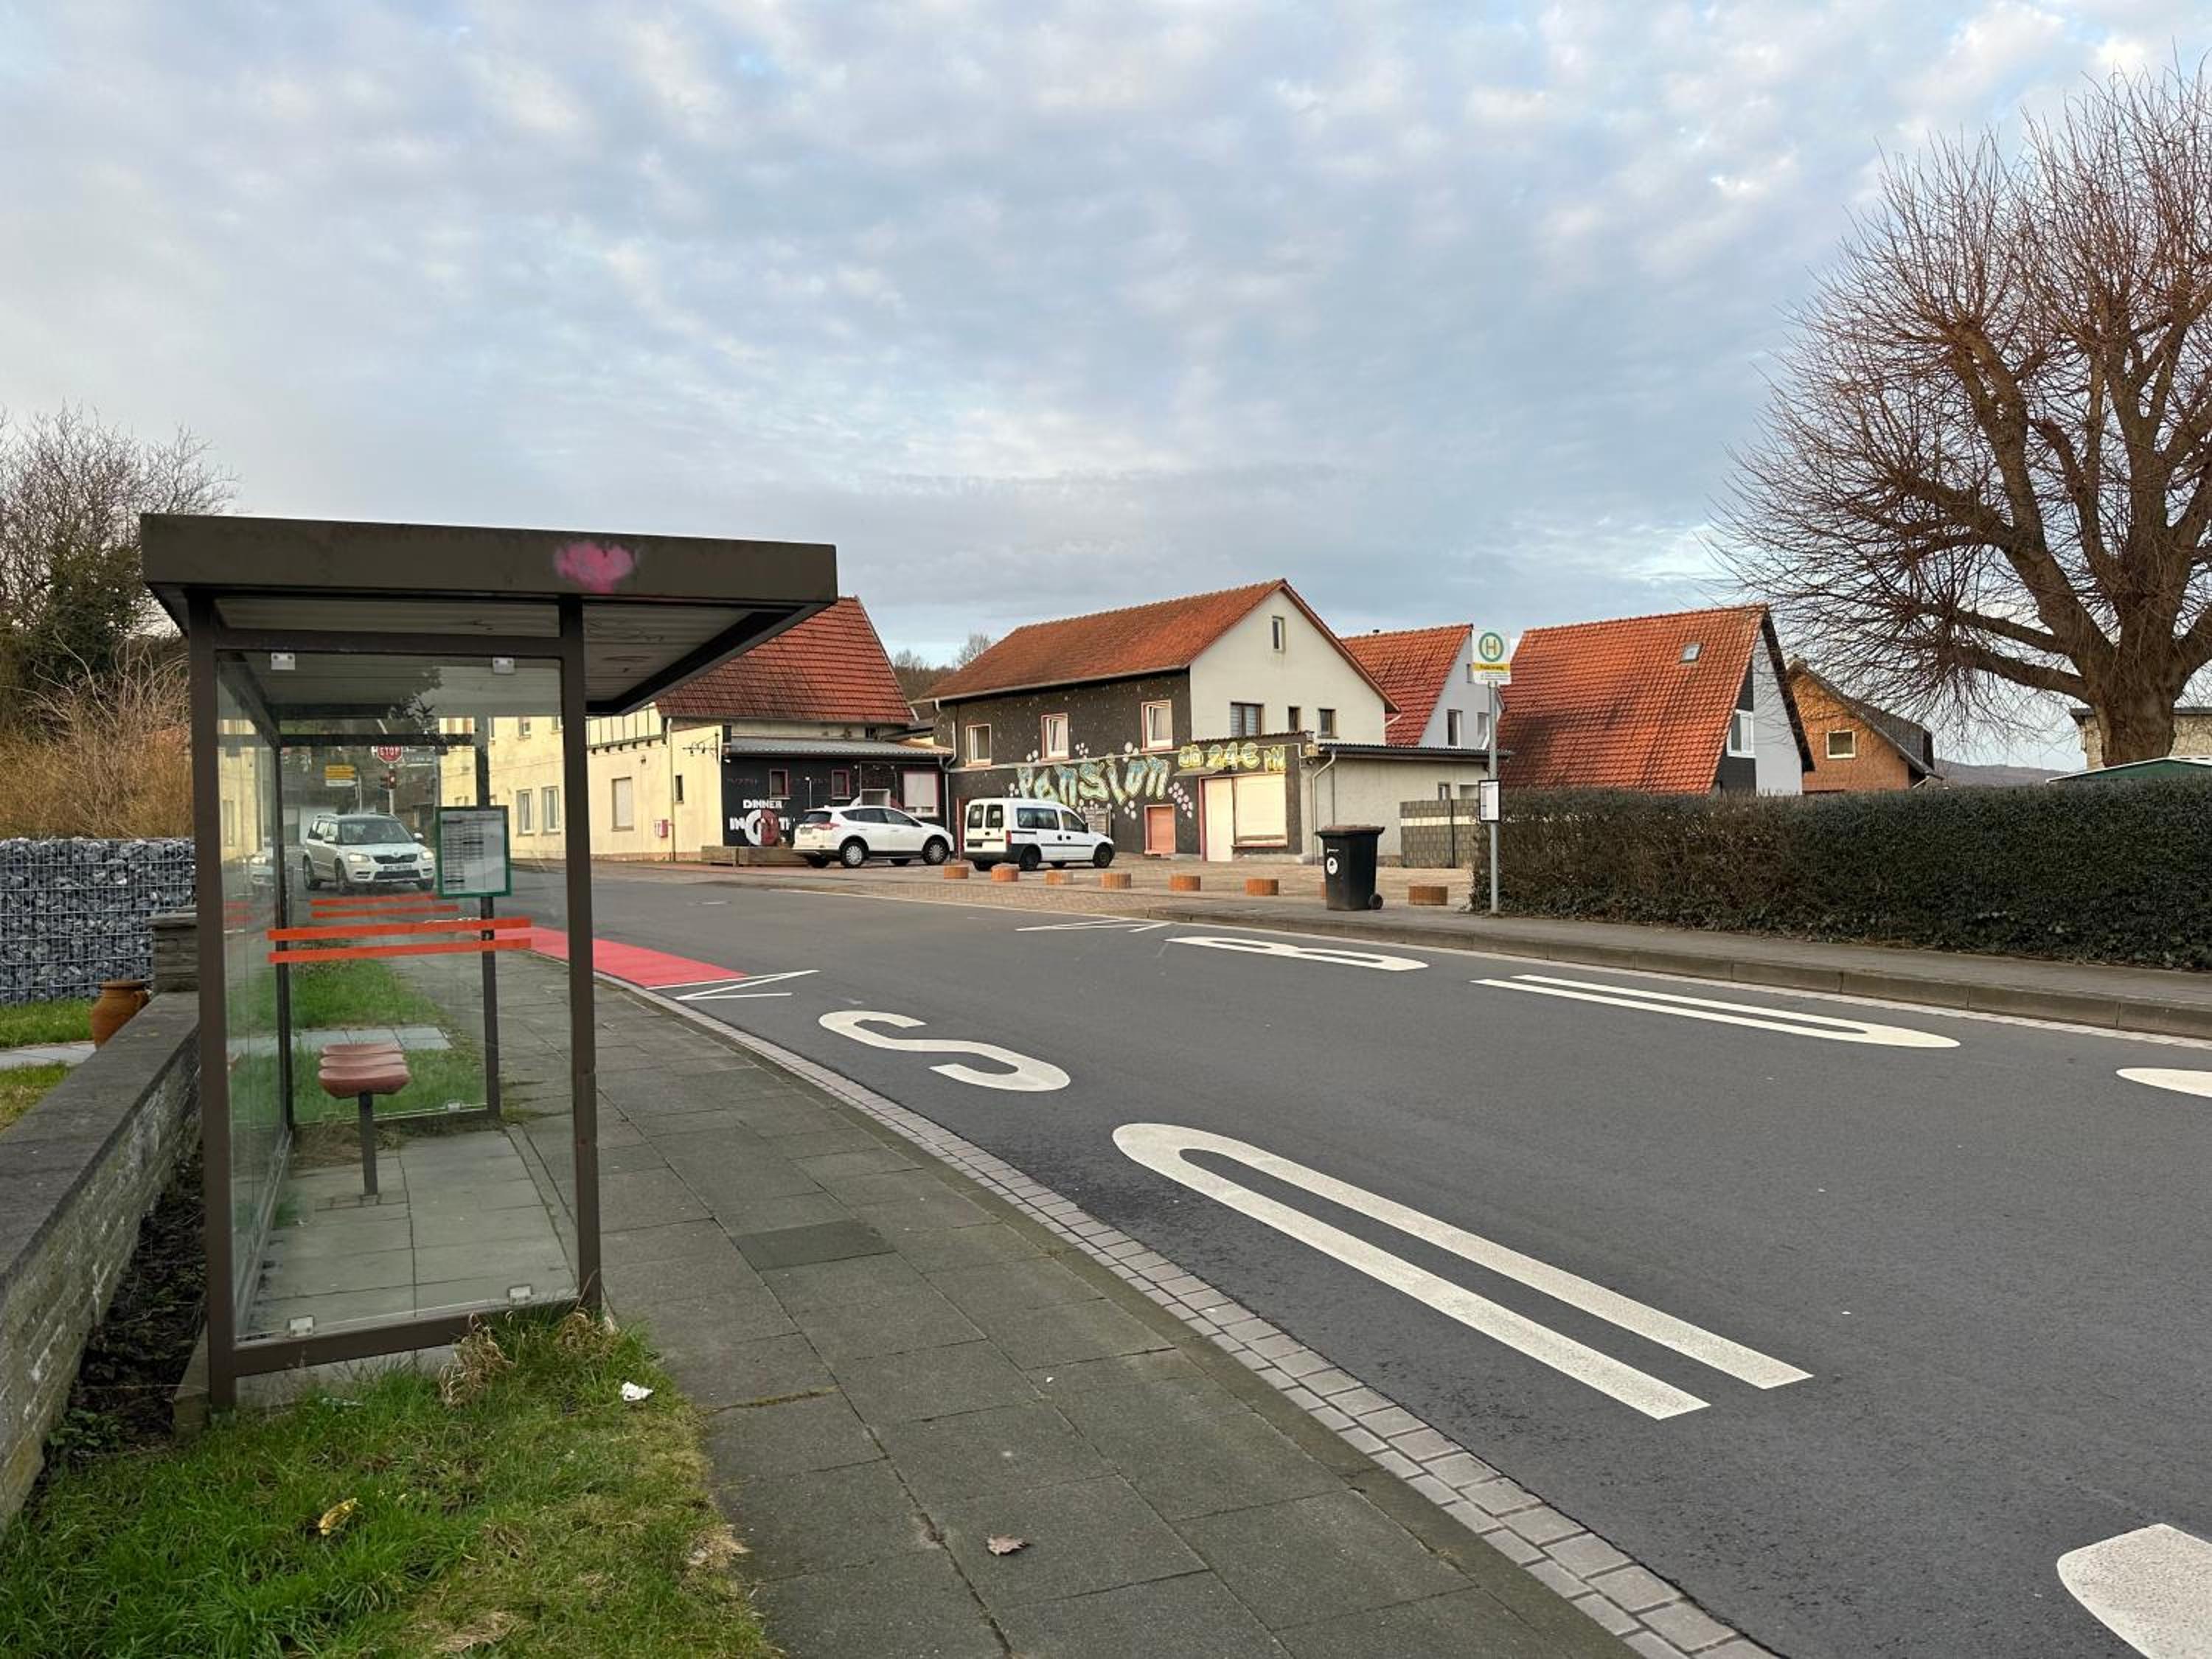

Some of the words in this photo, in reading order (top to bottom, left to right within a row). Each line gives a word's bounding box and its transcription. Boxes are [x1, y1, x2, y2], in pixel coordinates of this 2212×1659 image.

[1485, 638, 1496, 655] H
[379, 746, 400, 756] STOP
[742, 799, 782, 809] DINNER
